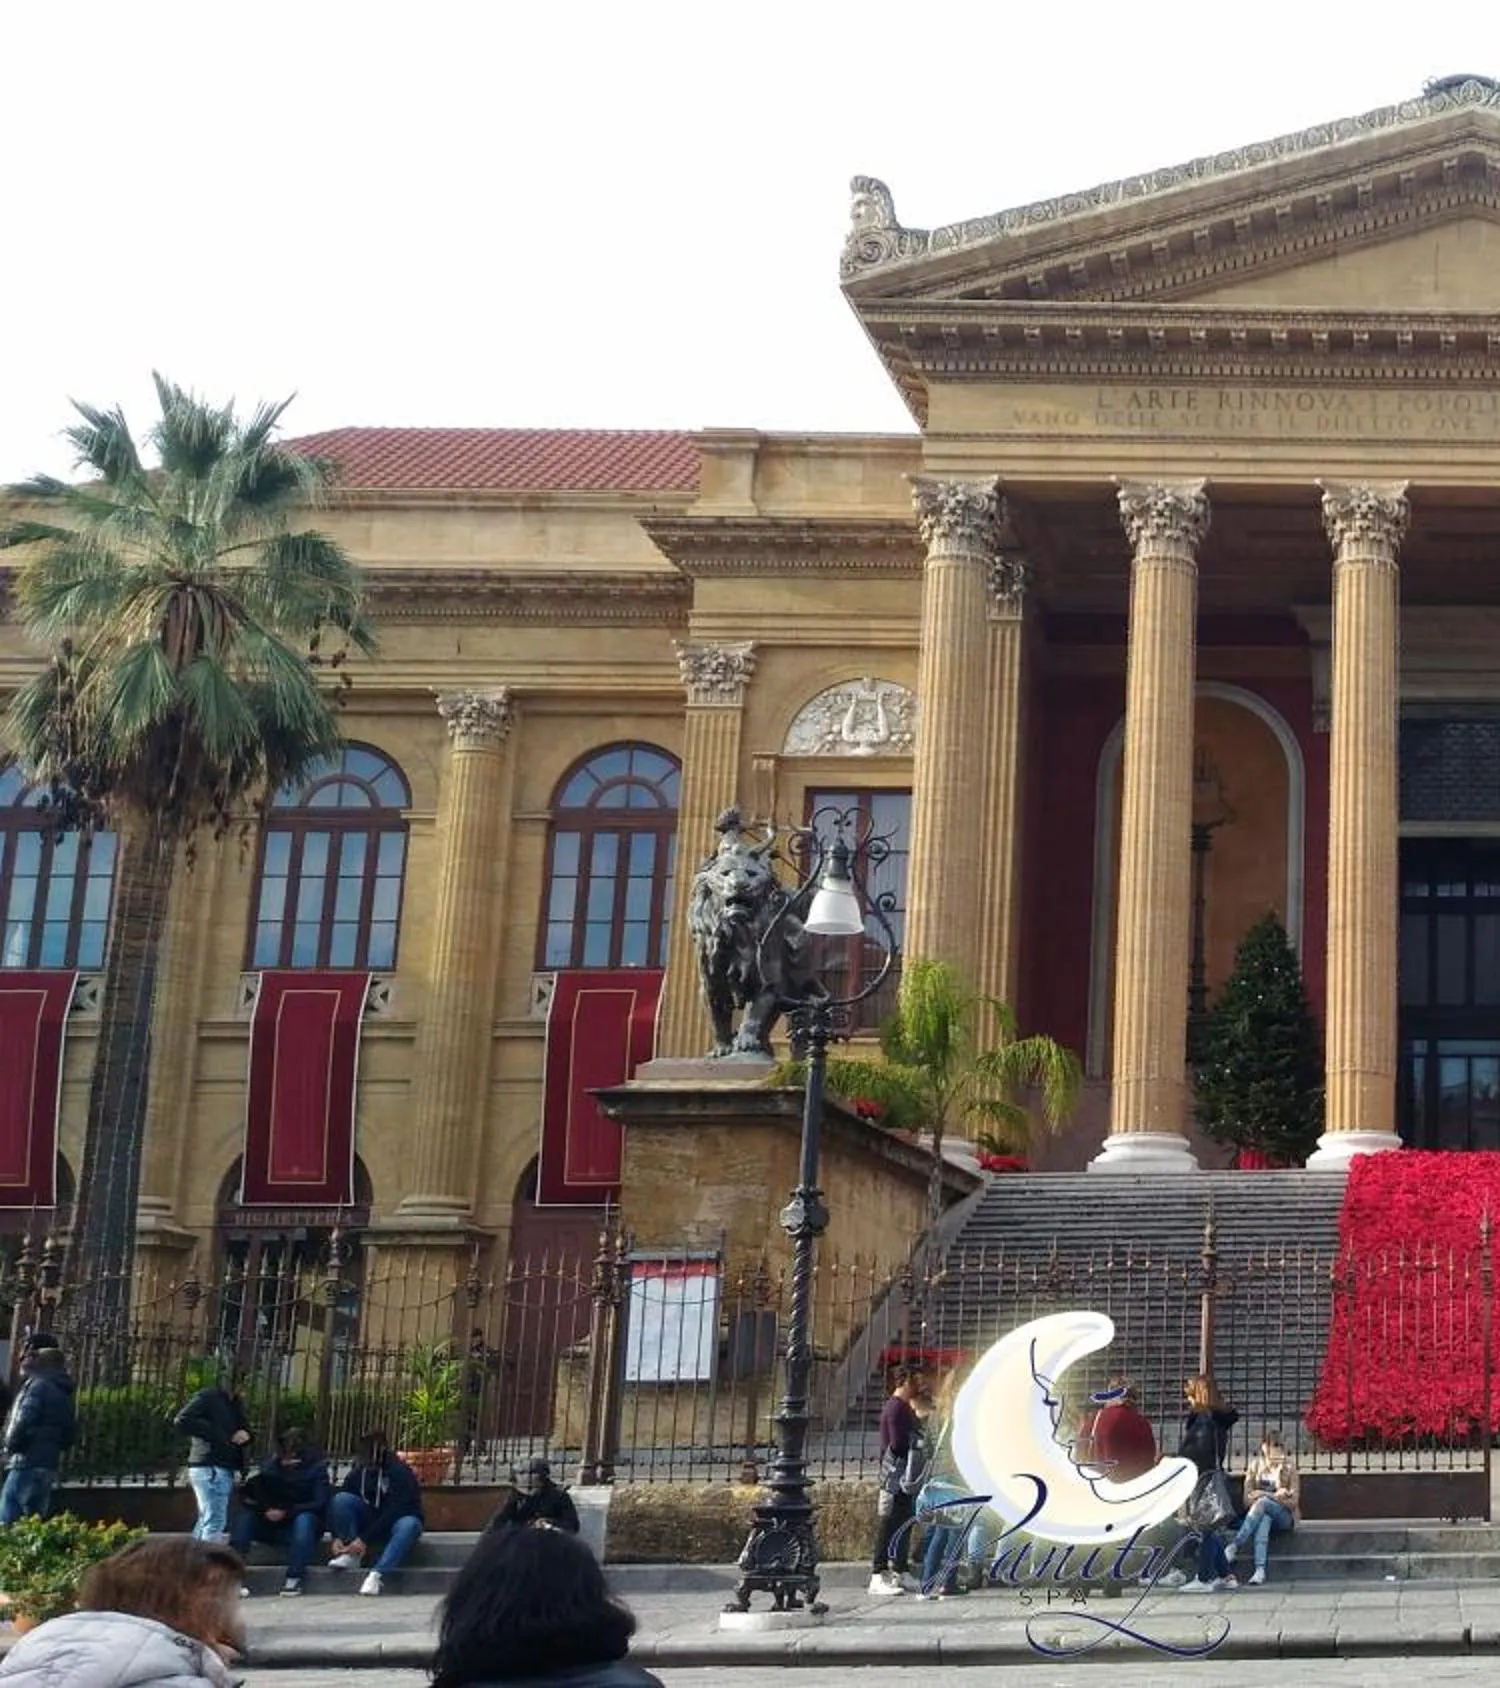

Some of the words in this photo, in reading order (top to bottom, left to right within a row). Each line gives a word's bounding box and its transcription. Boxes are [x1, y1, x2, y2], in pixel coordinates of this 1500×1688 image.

[1097, 388, 1199, 411] L'ARTE
[1218, 390, 1353, 412] RINNOVA
[1397, 393, 1498, 415] POPOLI
[1013, 409, 1080, 427] VANO
[1431, 416, 1476, 432] OVE
[235, 1211, 352, 1226] BIGLIETTERA
